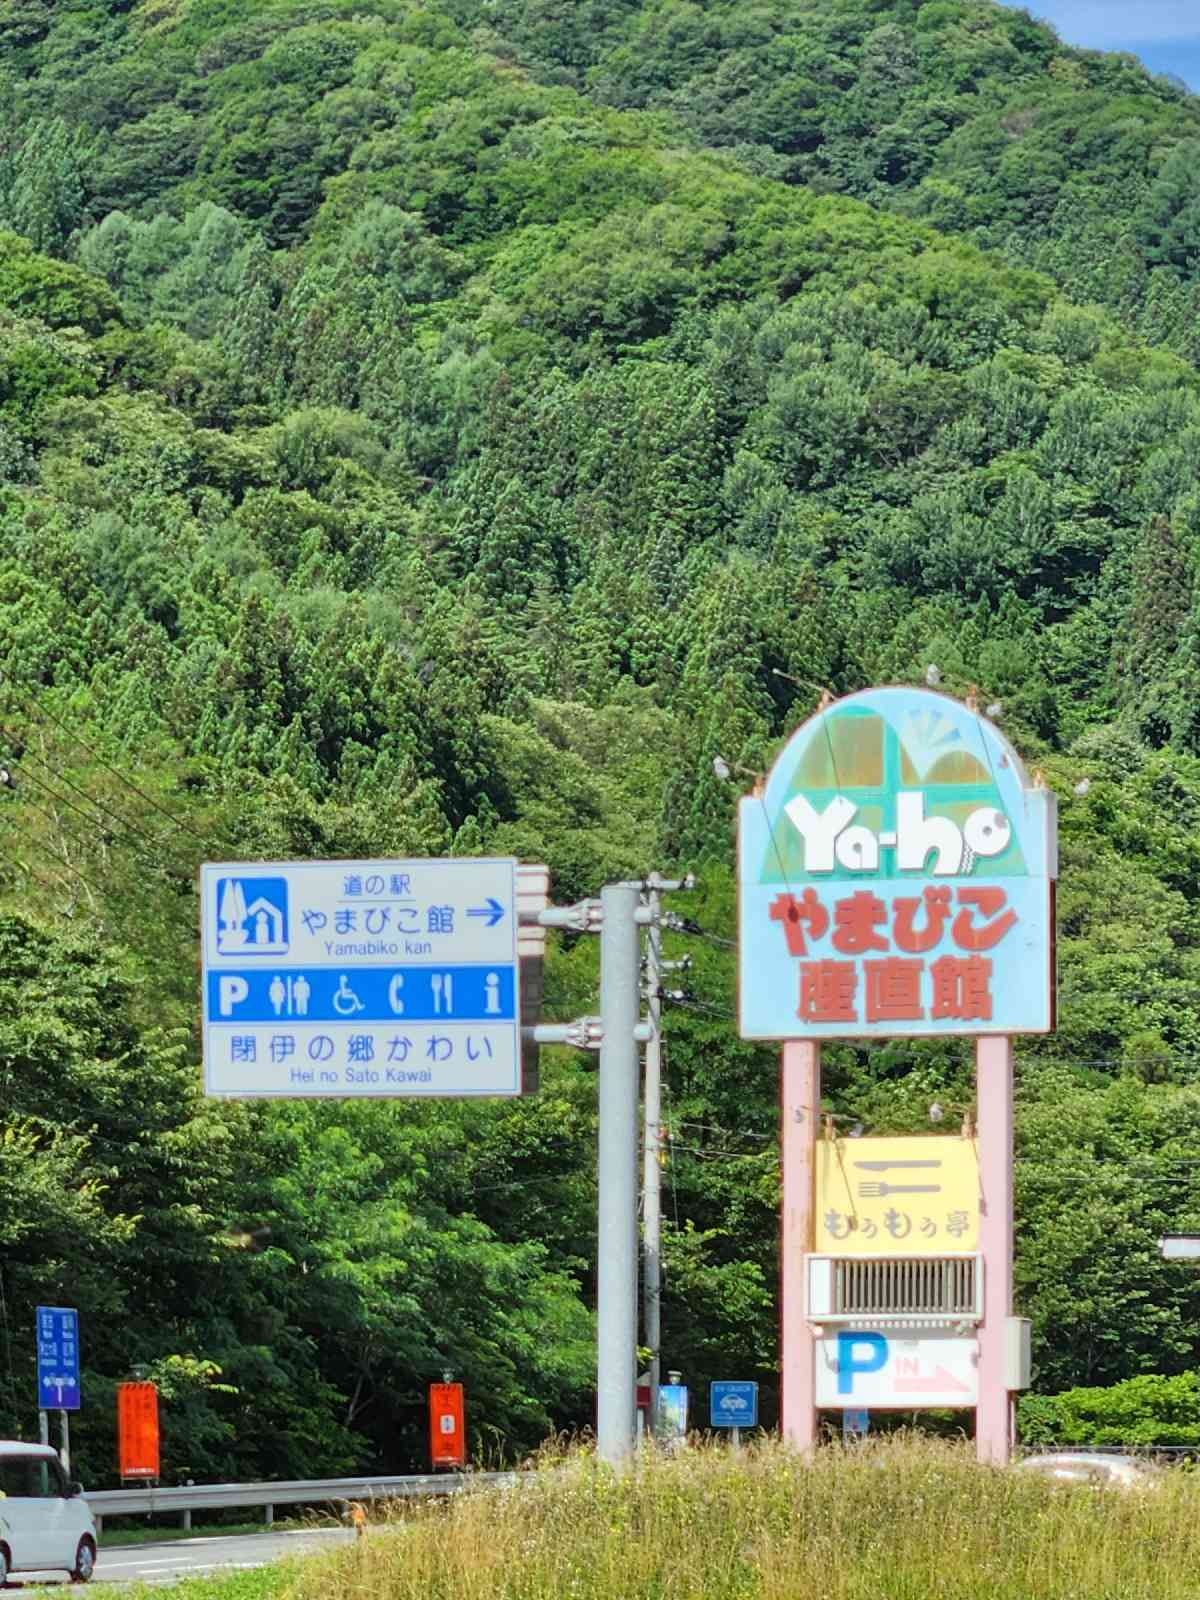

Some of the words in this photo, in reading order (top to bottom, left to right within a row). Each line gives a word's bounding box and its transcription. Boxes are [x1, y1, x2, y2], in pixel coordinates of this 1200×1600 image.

[783, 791, 1011, 876] Ya-ho
[344, 874, 411, 896] 道の駅
[302, 904, 455, 936] やまびこ館
[769, 885, 1018, 957] やまびこ
[324, 940, 398, 956] Yamabiko
[405, 940, 432, 954] kan
[796, 954, 994, 1024] 産直館
[230, 1034, 494, 1063] 閉伊の郷かわい
[290, 1068, 315, 1083] Hei
[320, 1071, 338, 1083] no
[346, 1068, 380, 1083] Sato
[385, 1067, 432, 1083] Kawai
[837, 1330, 889, 1394] P
[894, 1358, 920, 1376] IN
